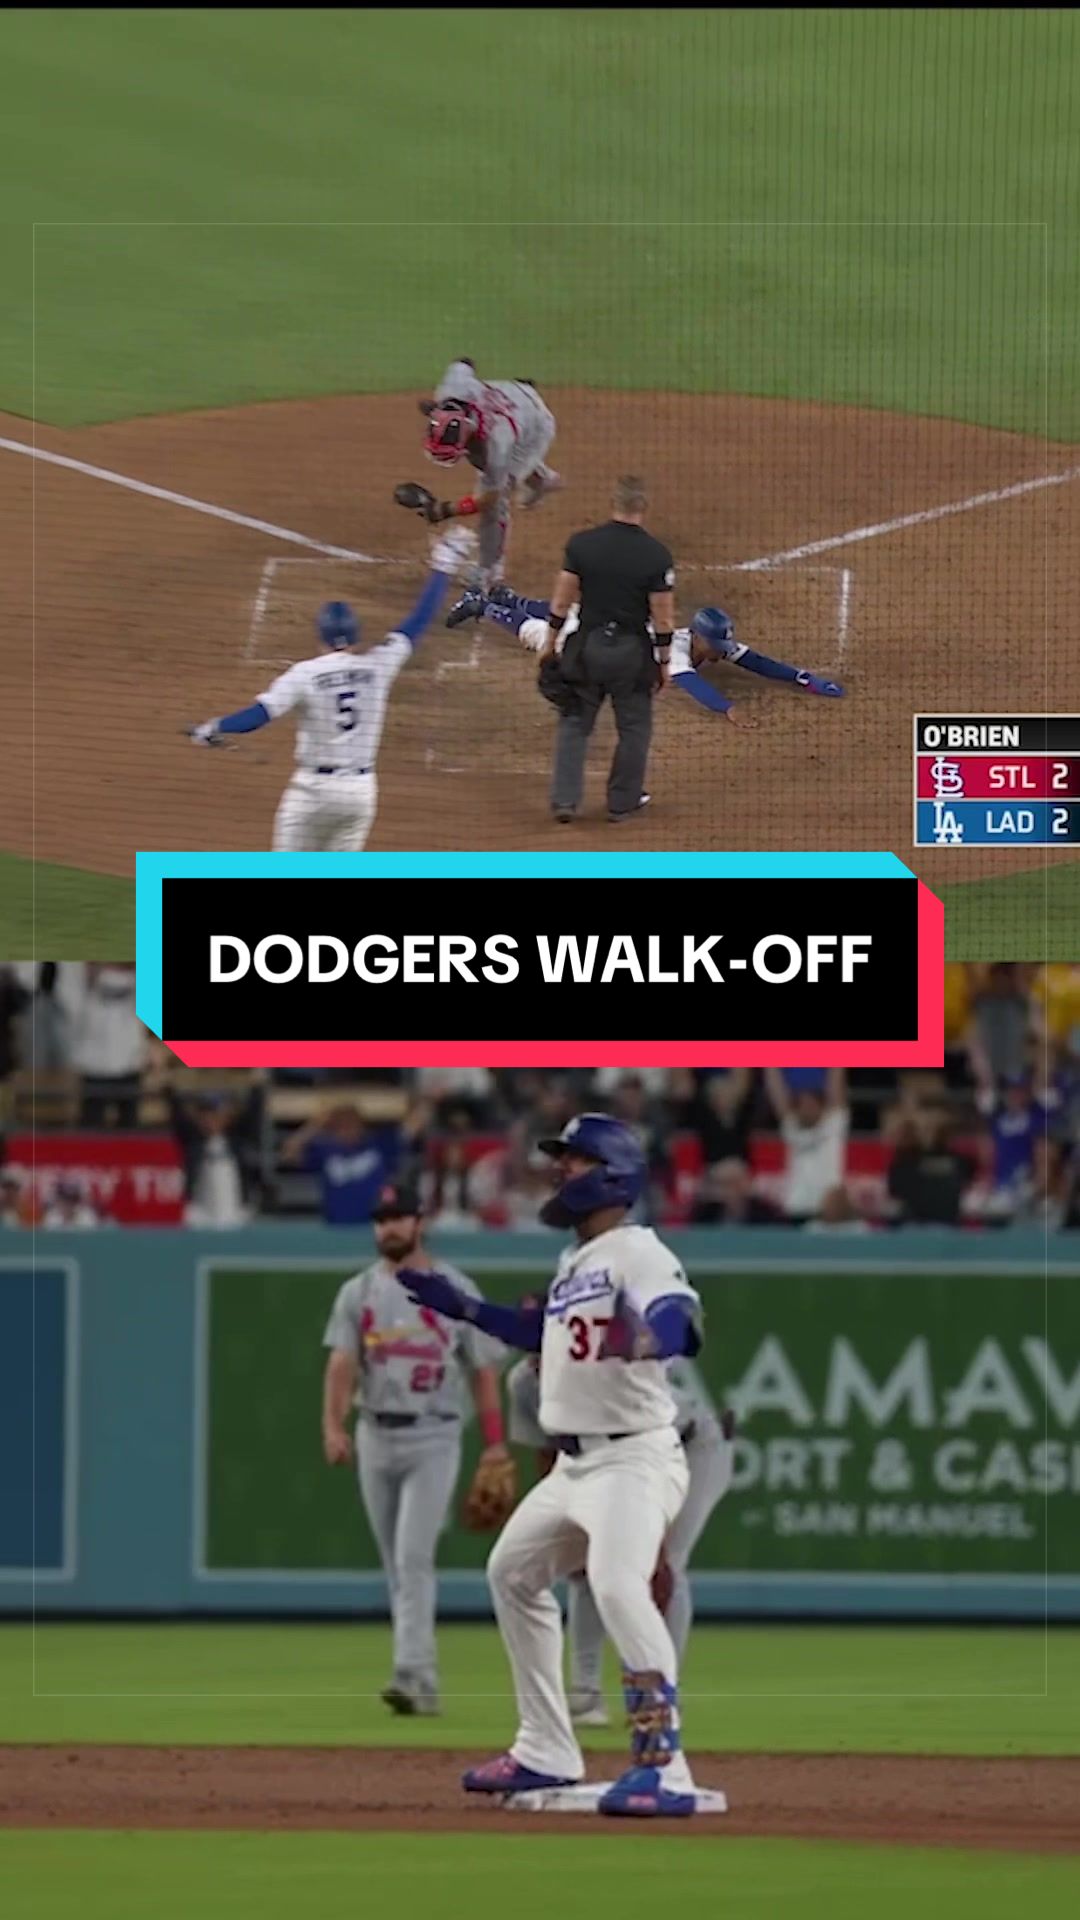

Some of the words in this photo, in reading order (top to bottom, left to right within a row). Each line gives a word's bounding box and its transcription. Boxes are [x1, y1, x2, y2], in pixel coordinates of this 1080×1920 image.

[336, 691, 358, 734] 5
[568, 1315, 615, 1361] 37
[869, 1438, 913, 1491] &
[773, 1502, 859, 1538] SAN
[866, 1502, 1034, 1539] MANUEL
